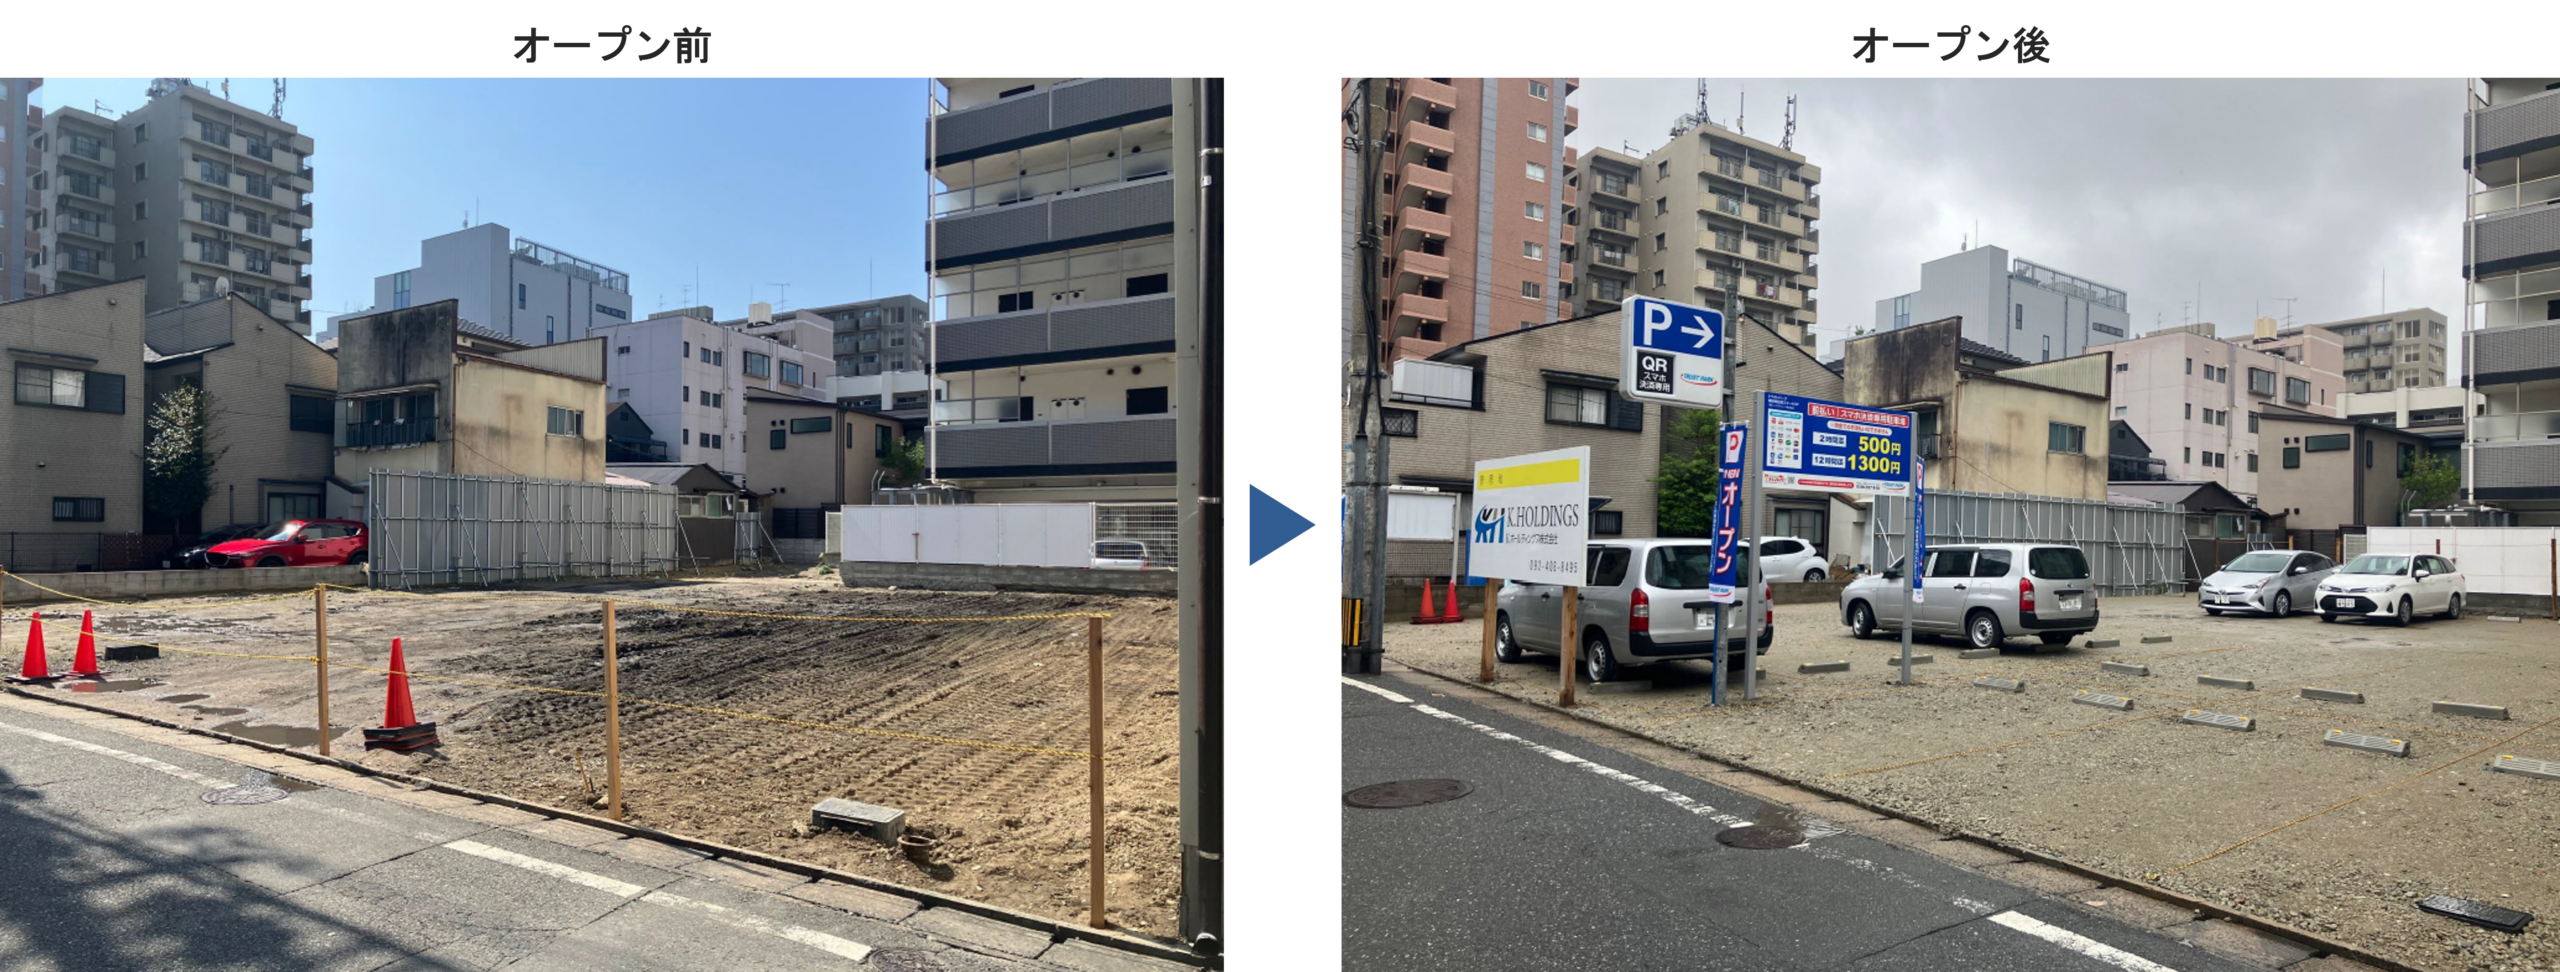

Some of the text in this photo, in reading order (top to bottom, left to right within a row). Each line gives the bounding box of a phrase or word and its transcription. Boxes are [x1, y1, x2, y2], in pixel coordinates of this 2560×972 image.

[1643, 302, 1672, 346] P
[1642, 356, 1667, 372] QR
[1639, 380, 1670, 392] 決済専用
[1643, 372, 1667, 382] スマホ
[1727, 434, 1739, 460] P
[1858, 436, 1901, 456] 500円
[1848, 454, 1901, 475] 1300円
[1506, 504, 1579, 528] K.HOLDINGS
[1716, 481, 1738, 574] オープン
